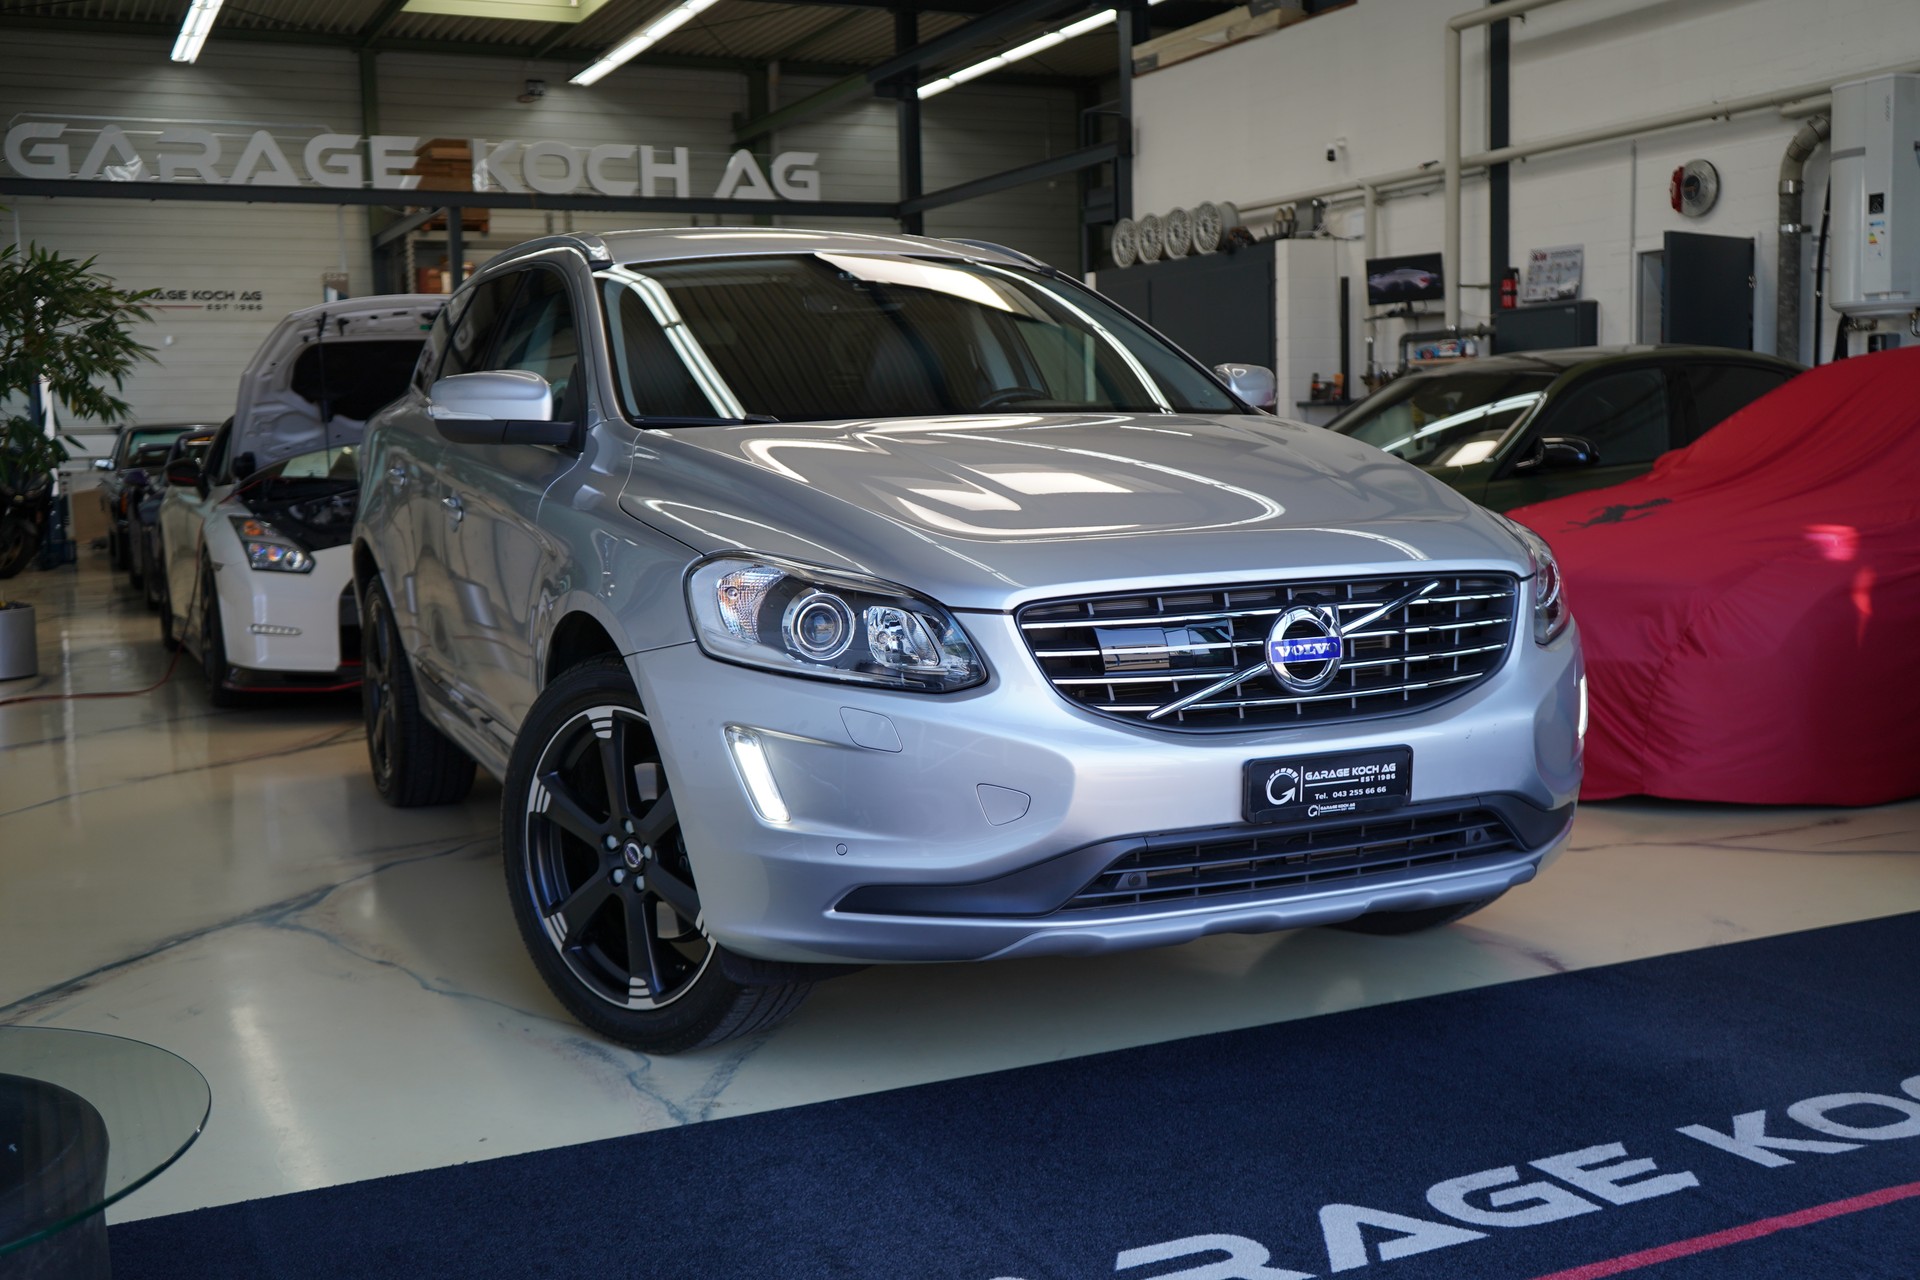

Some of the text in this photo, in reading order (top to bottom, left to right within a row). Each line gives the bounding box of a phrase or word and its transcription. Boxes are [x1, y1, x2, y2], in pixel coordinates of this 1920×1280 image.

[4, 121, 820, 200] GARAGE KOCH AG
[192, 290, 235, 301] KOCH
[239, 290, 263, 301] AG
[1275, 642, 1338, 658] VOLVO
[1305, 763, 1396, 780] GARAGE KOCH AG
[1360, 773, 1396, 783] EST 1986
[1315, 792, 1329, 800] Tel.
[1332, 790, 1347, 798] 043
[1349, 789, 1363, 797] 255
[1365, 787, 1376, 795] 66
[1676, 1075, 1920, 1168] KO
